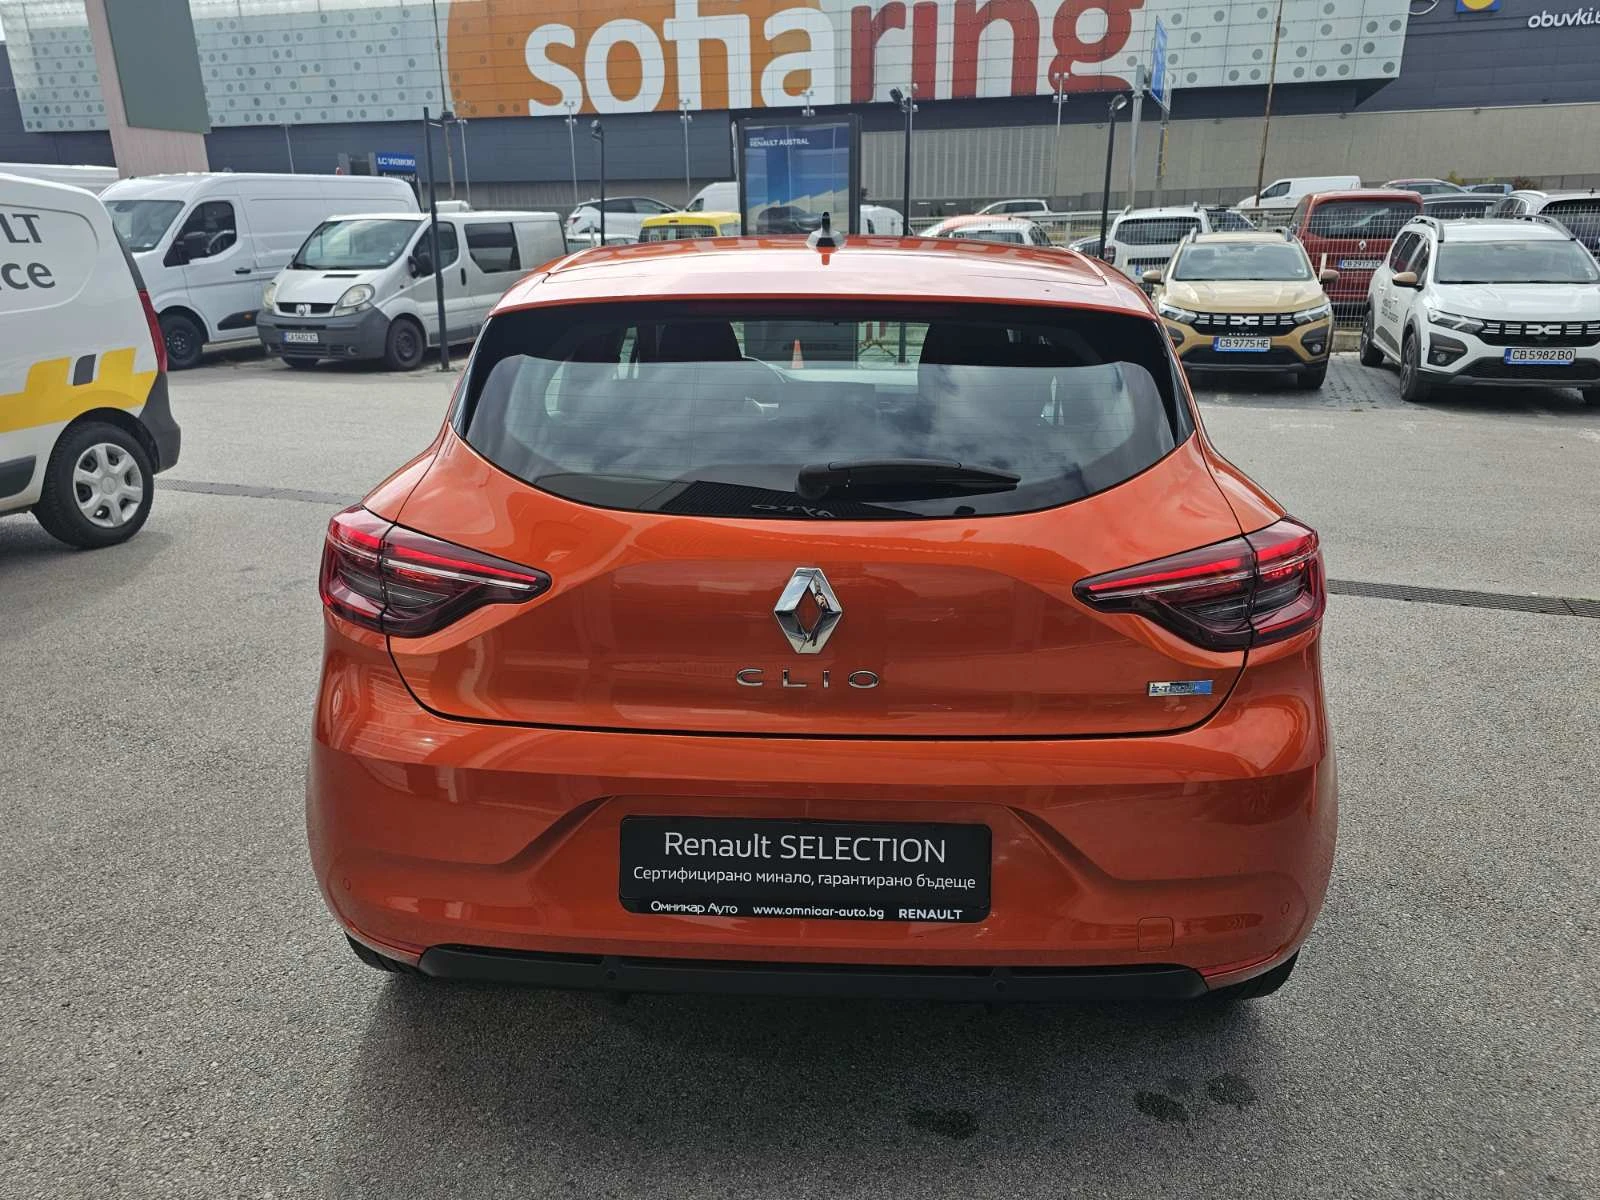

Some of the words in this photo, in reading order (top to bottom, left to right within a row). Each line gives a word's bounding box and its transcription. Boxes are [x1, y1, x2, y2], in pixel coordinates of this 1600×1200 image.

[779, 138, 810, 147] AUSTRAL
[0, 262, 56, 290] ce
[1233, 339, 1255, 348] 9775
[1528, 350, 1557, 360] 5982
[736, 668, 880, 688] CLIO
[664, 832, 772, 858] Renault
[780, 835, 945, 863] SELECTION
[633, 866, 752, 884] Сертифицирано
[756, 872, 814, 885] минало,
[818, 874, 913, 888] гарантирано
[916, 874, 976, 890] бъдеще
[650, 900, 705, 914] Омникар
[707, 902, 738, 915] Ауто
[753, 906, 884, 919] www.omnicar-auto.bg
[898, 908, 963, 920] RENAULT
